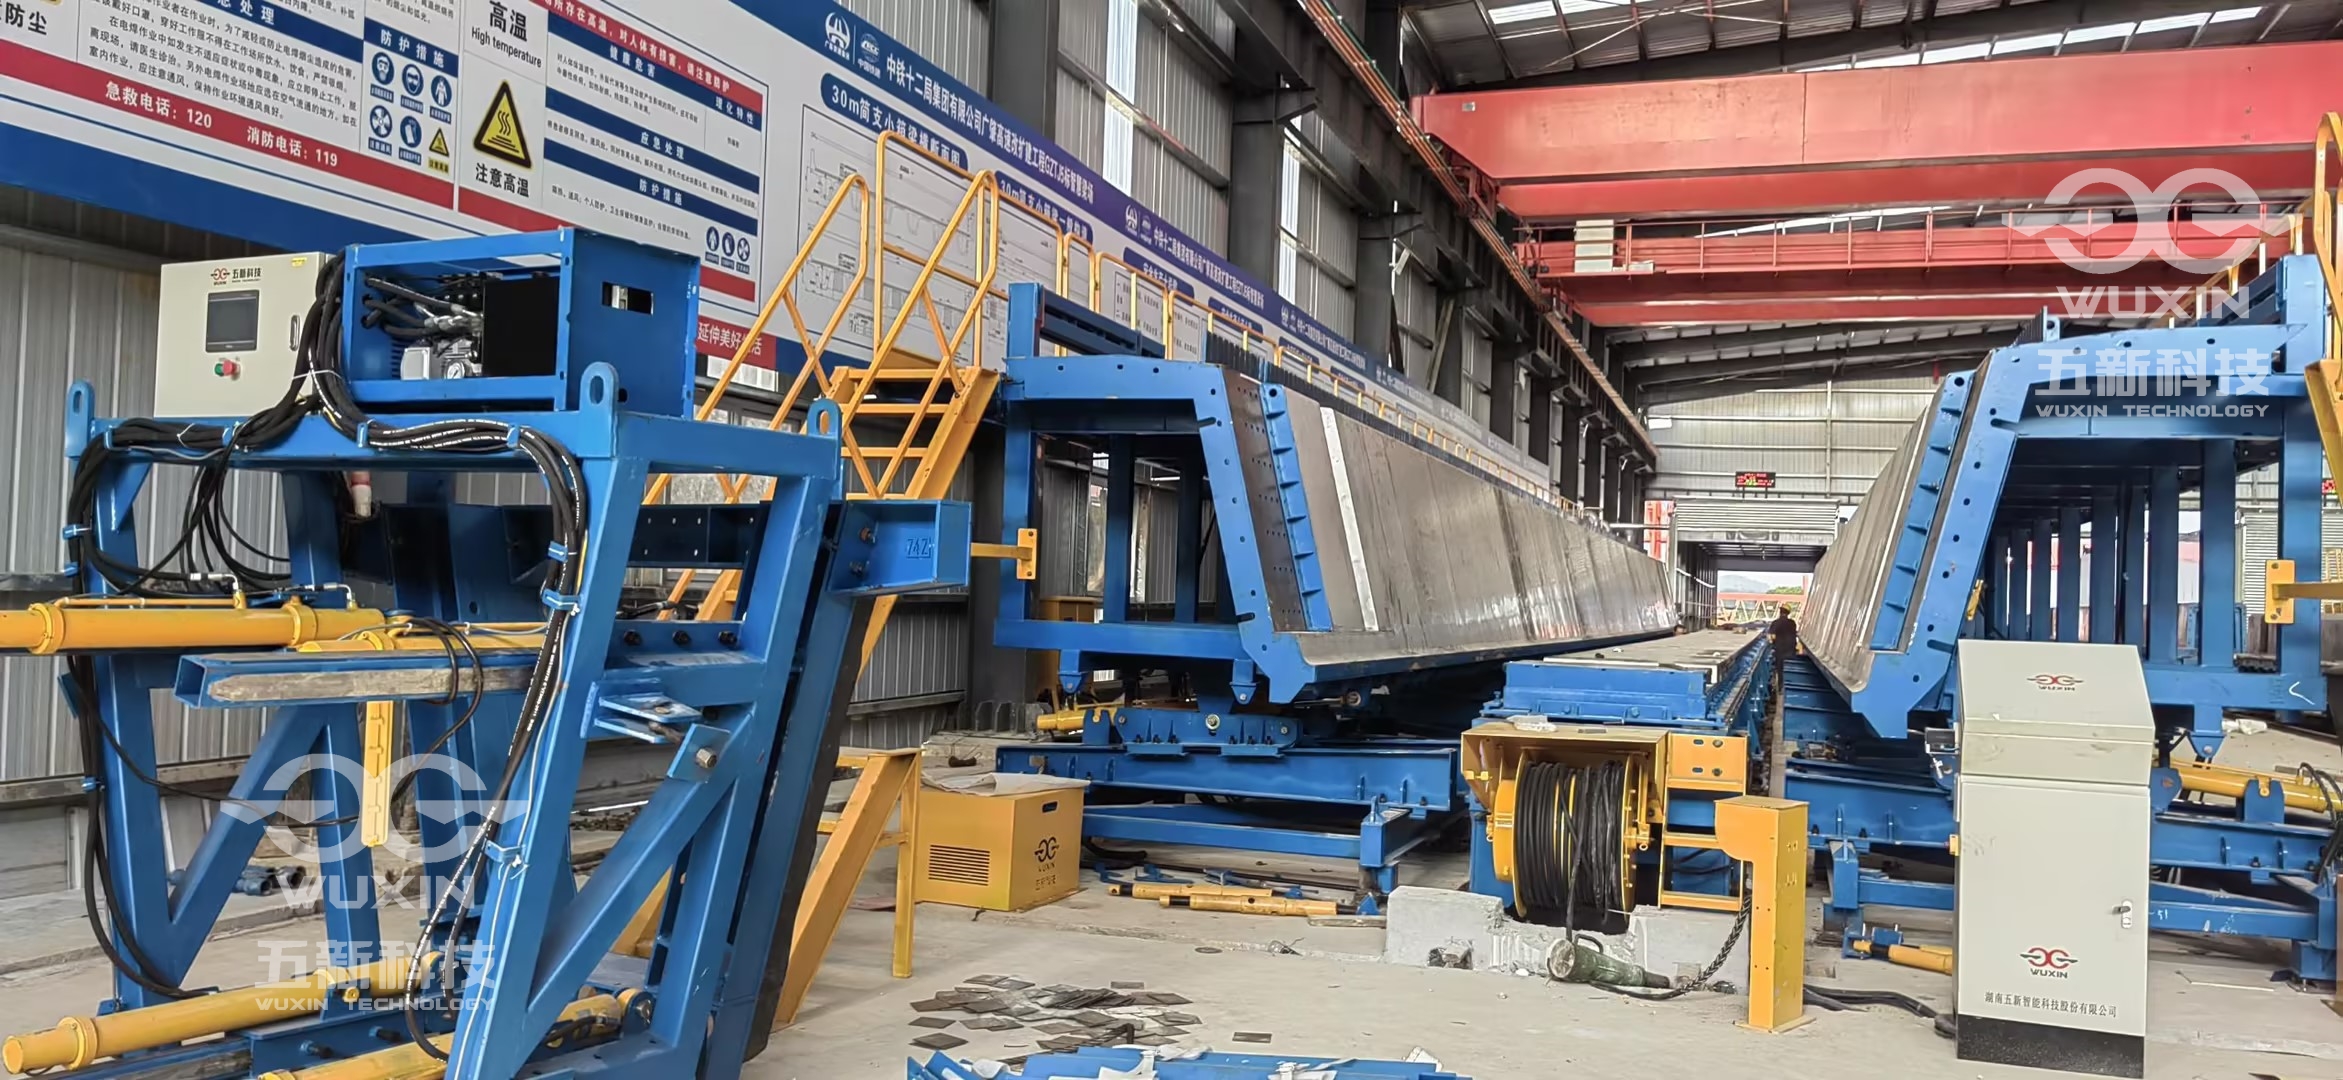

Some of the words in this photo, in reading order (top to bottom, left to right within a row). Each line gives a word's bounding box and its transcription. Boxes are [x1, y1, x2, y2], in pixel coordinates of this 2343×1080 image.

[0, 1, 47, 36] 防尘
[489, 0, 528, 42] 高温
[380, 28, 445, 68] 防护措施
[471, 26, 491, 46] High
[492, 36, 543, 68] temperature
[640, 131, 685, 160] 应急处理
[475, 162, 529, 198] 注意高温
[639, 178, 683, 206] 防护措施
[697, 322, 762, 356] 延伸美好活
[2030, 968, 2068, 979] WUXIN
[1984, 991, 2118, 1019] 湖南五新智能科技股份有限公司
